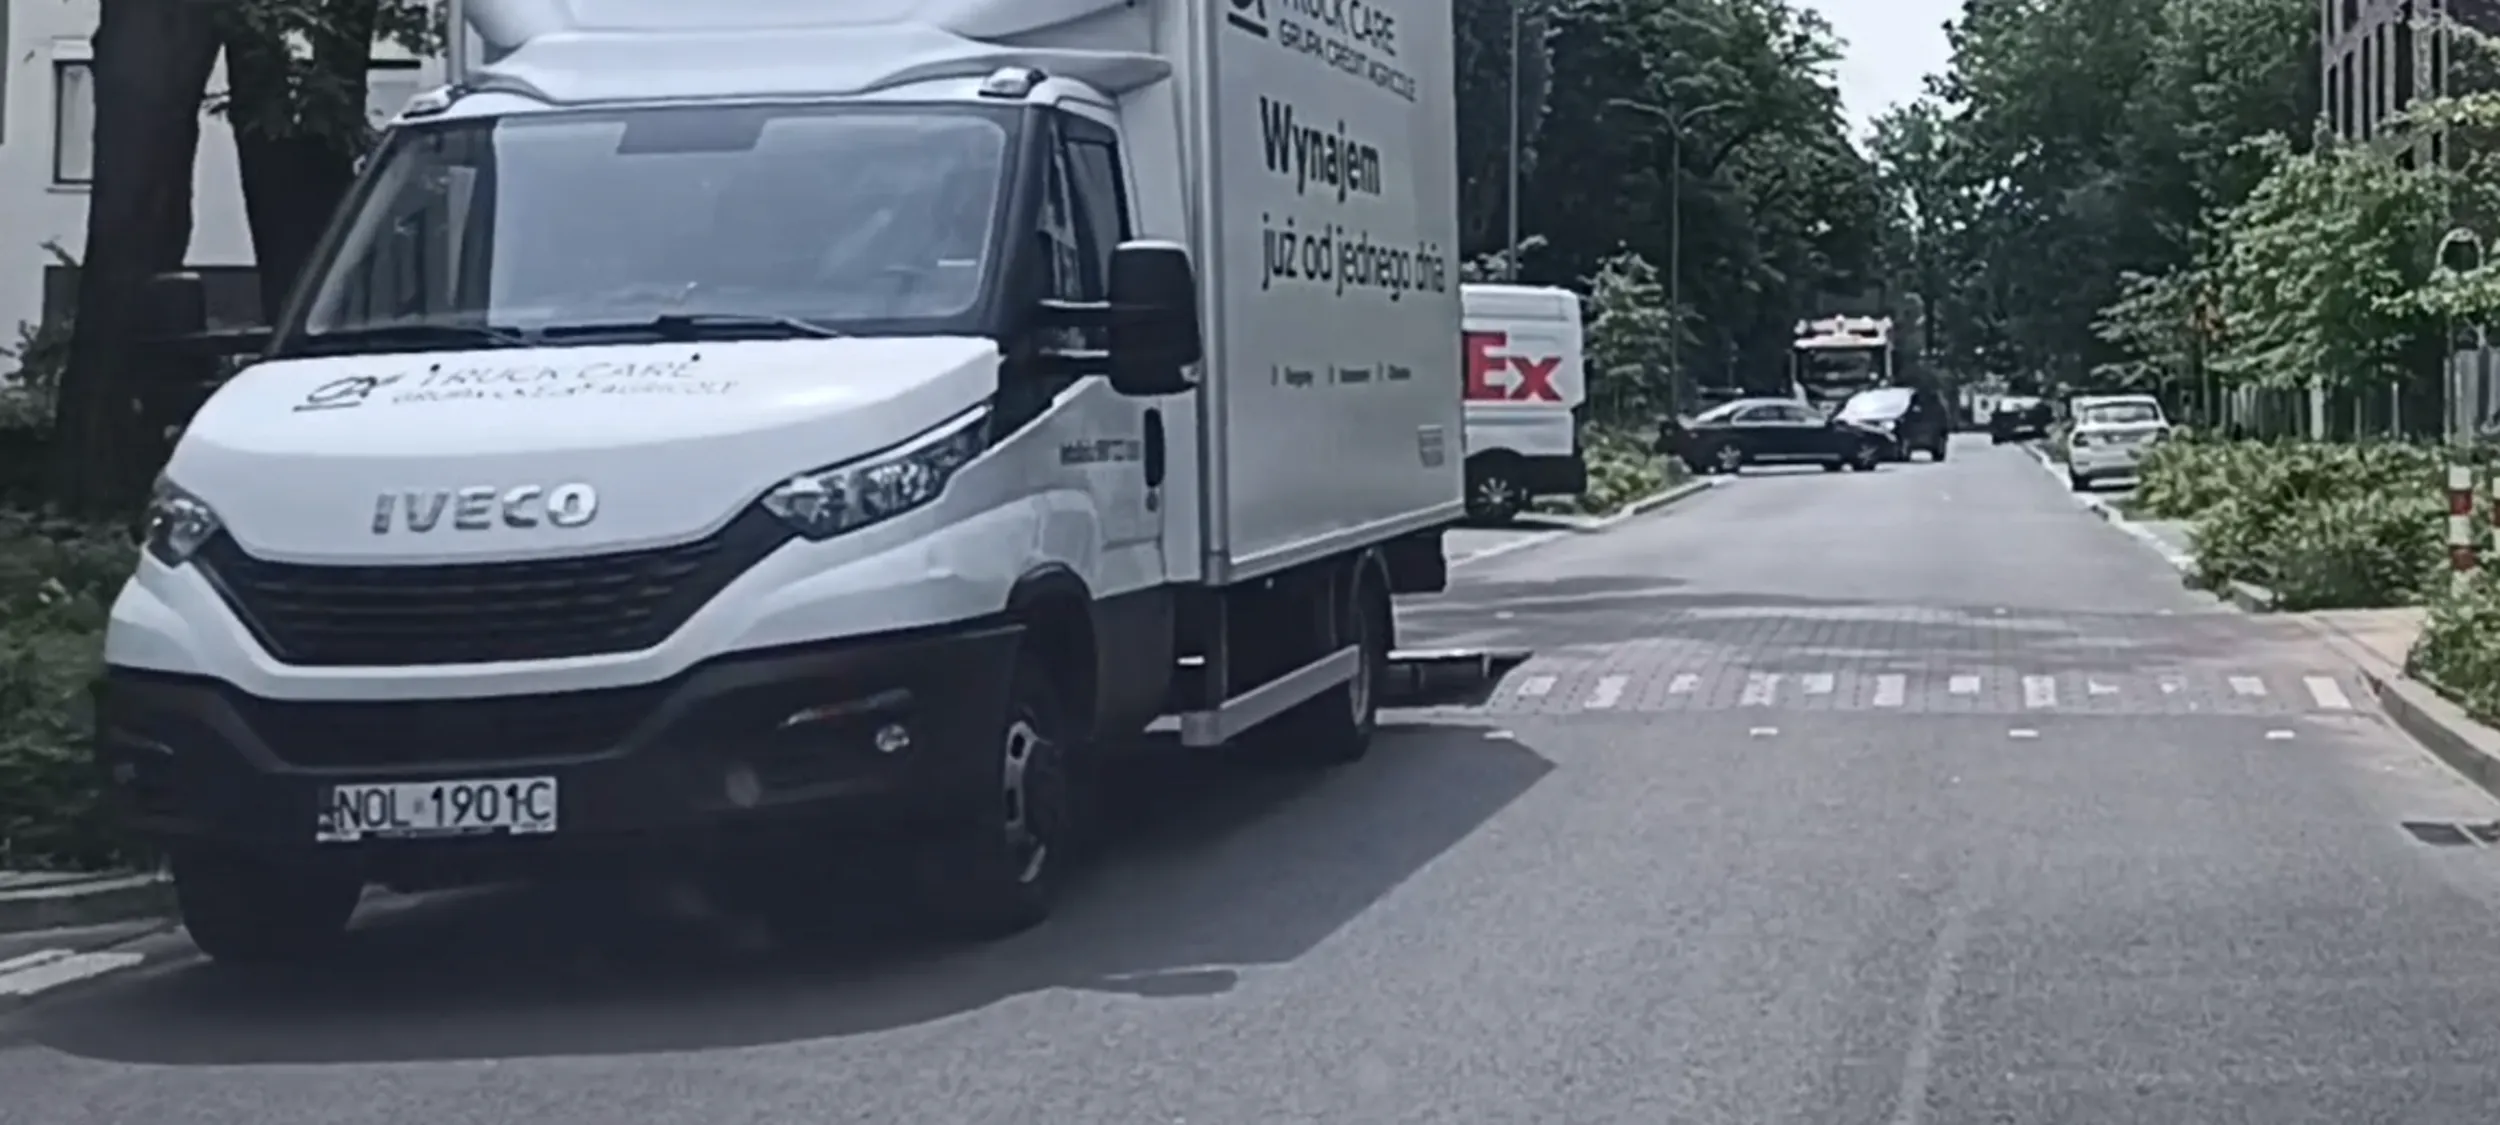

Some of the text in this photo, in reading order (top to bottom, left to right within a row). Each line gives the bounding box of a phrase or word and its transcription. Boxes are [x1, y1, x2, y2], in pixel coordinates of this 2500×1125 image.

[1260, 95, 1381, 204] Wynajem
[1261, 211, 1446, 302] już od jednego dnia
[372, 482, 599, 535] IVECO
[338, 780, 551, 829] NOL 1901C
